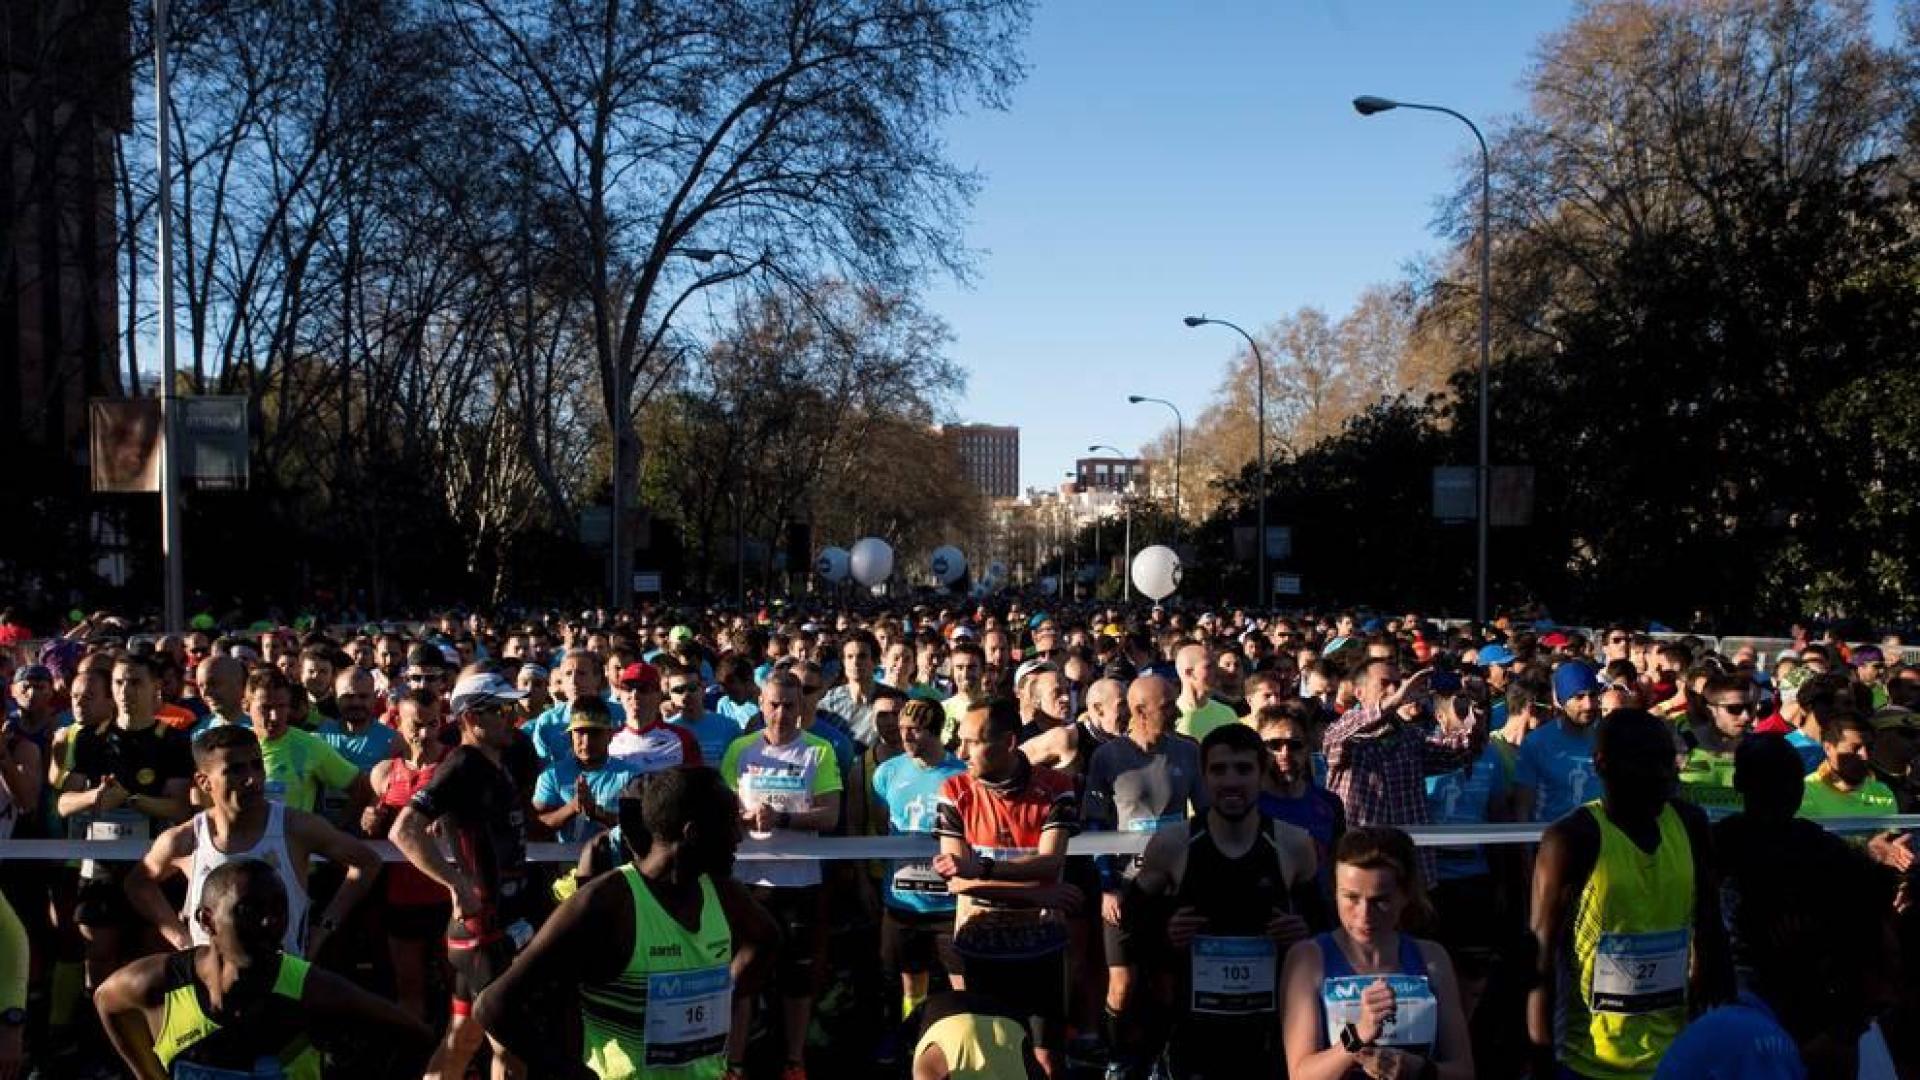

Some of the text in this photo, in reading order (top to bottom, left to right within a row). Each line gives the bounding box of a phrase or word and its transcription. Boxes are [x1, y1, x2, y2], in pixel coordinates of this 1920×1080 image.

[1222, 965, 1251, 981] 103
[1636, 963, 1657, 980] 27
[685, 1005, 706, 1024] 16
